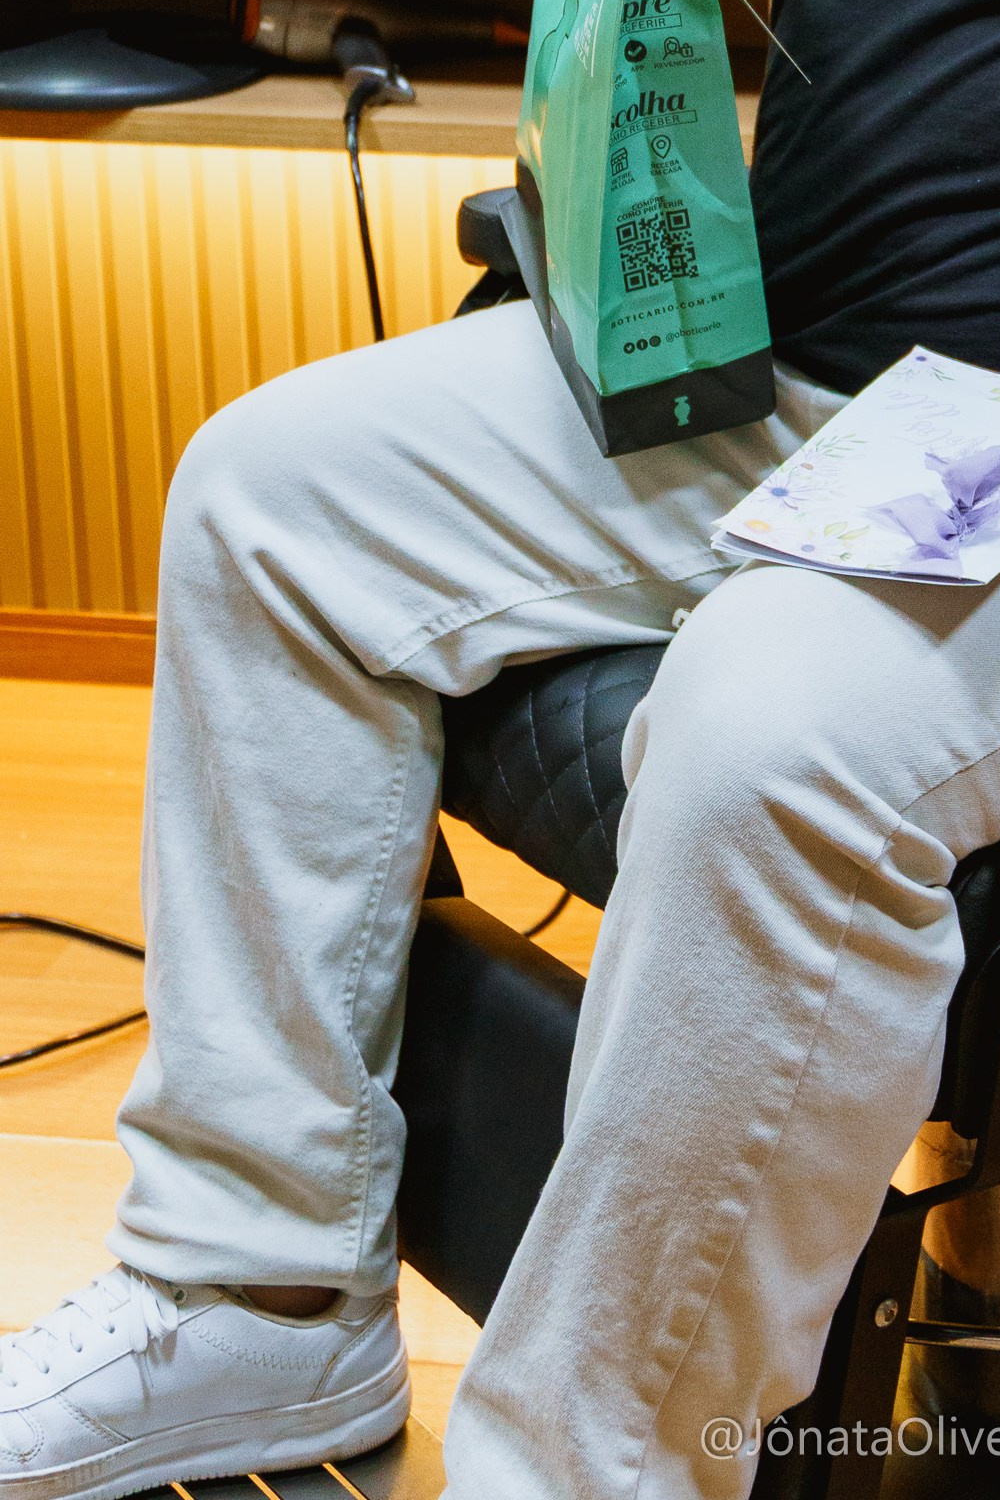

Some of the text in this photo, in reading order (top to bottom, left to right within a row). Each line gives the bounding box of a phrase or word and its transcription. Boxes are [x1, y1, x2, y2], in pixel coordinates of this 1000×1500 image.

[631, 64, 645, 73] APP
[653, 57, 706, 69] REVENDEDOR
[629, 114, 681, 134] RECEBER
[650, 159, 680, 170] RECEBA
[650, 165, 683, 177] EM CASA
[619, 177, 636, 189] LOJA
[631, 195, 665, 211] COMPRE
[616, 199, 685, 222] COMO PREFERIR
[665, 320, 722, 342] @oboticario
